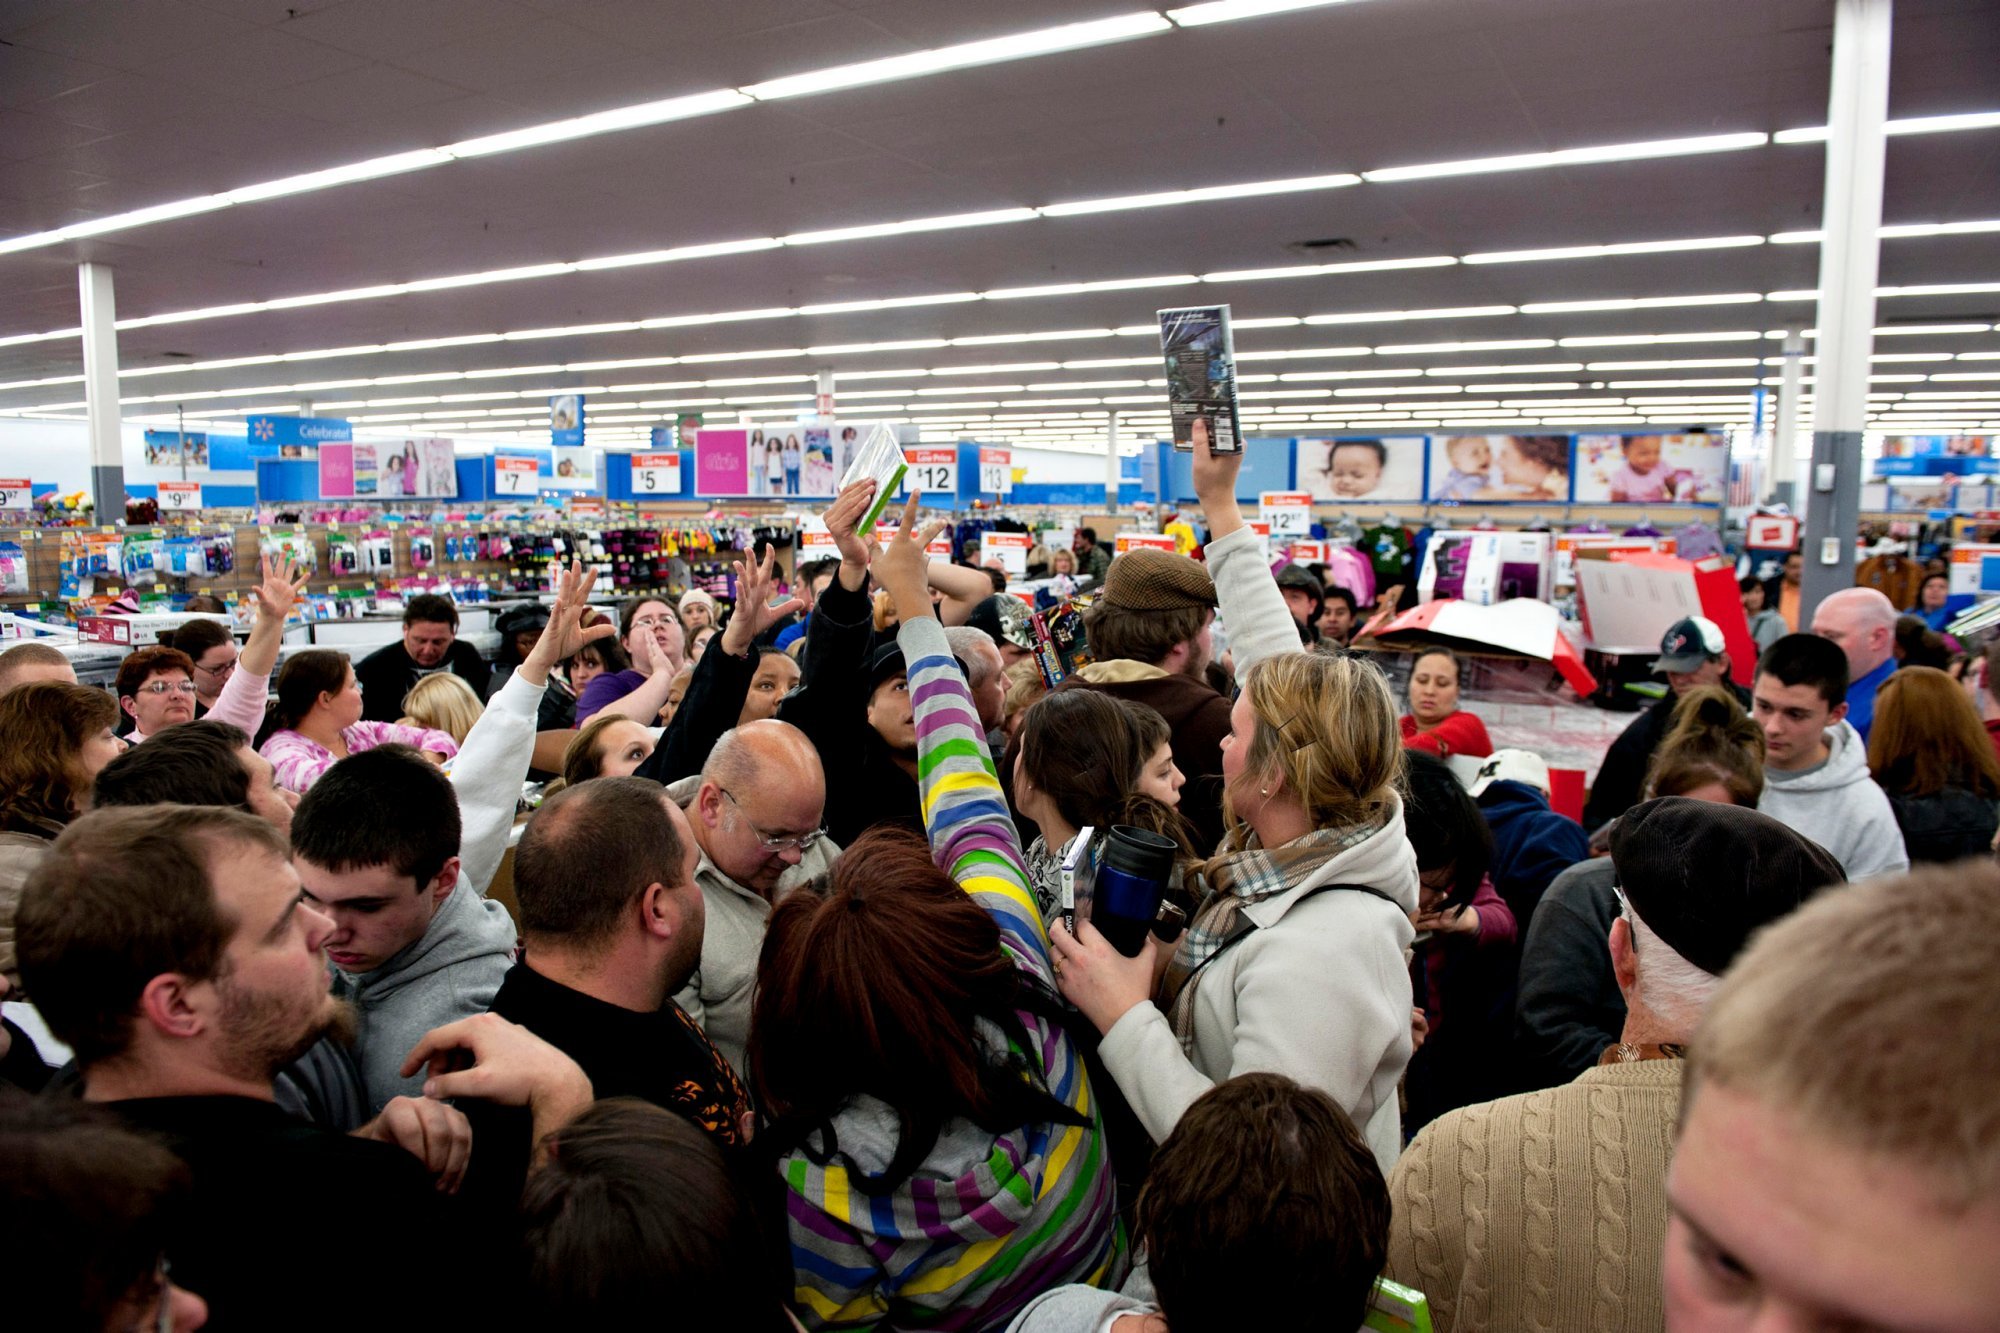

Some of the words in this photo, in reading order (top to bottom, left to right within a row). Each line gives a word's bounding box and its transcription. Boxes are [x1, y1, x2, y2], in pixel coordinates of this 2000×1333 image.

[299, 424, 350, 439] Celebrate!
[504, 473, 519, 491] $7
[640, 470, 656, 490] $5
[917, 466, 950, 489] $12
